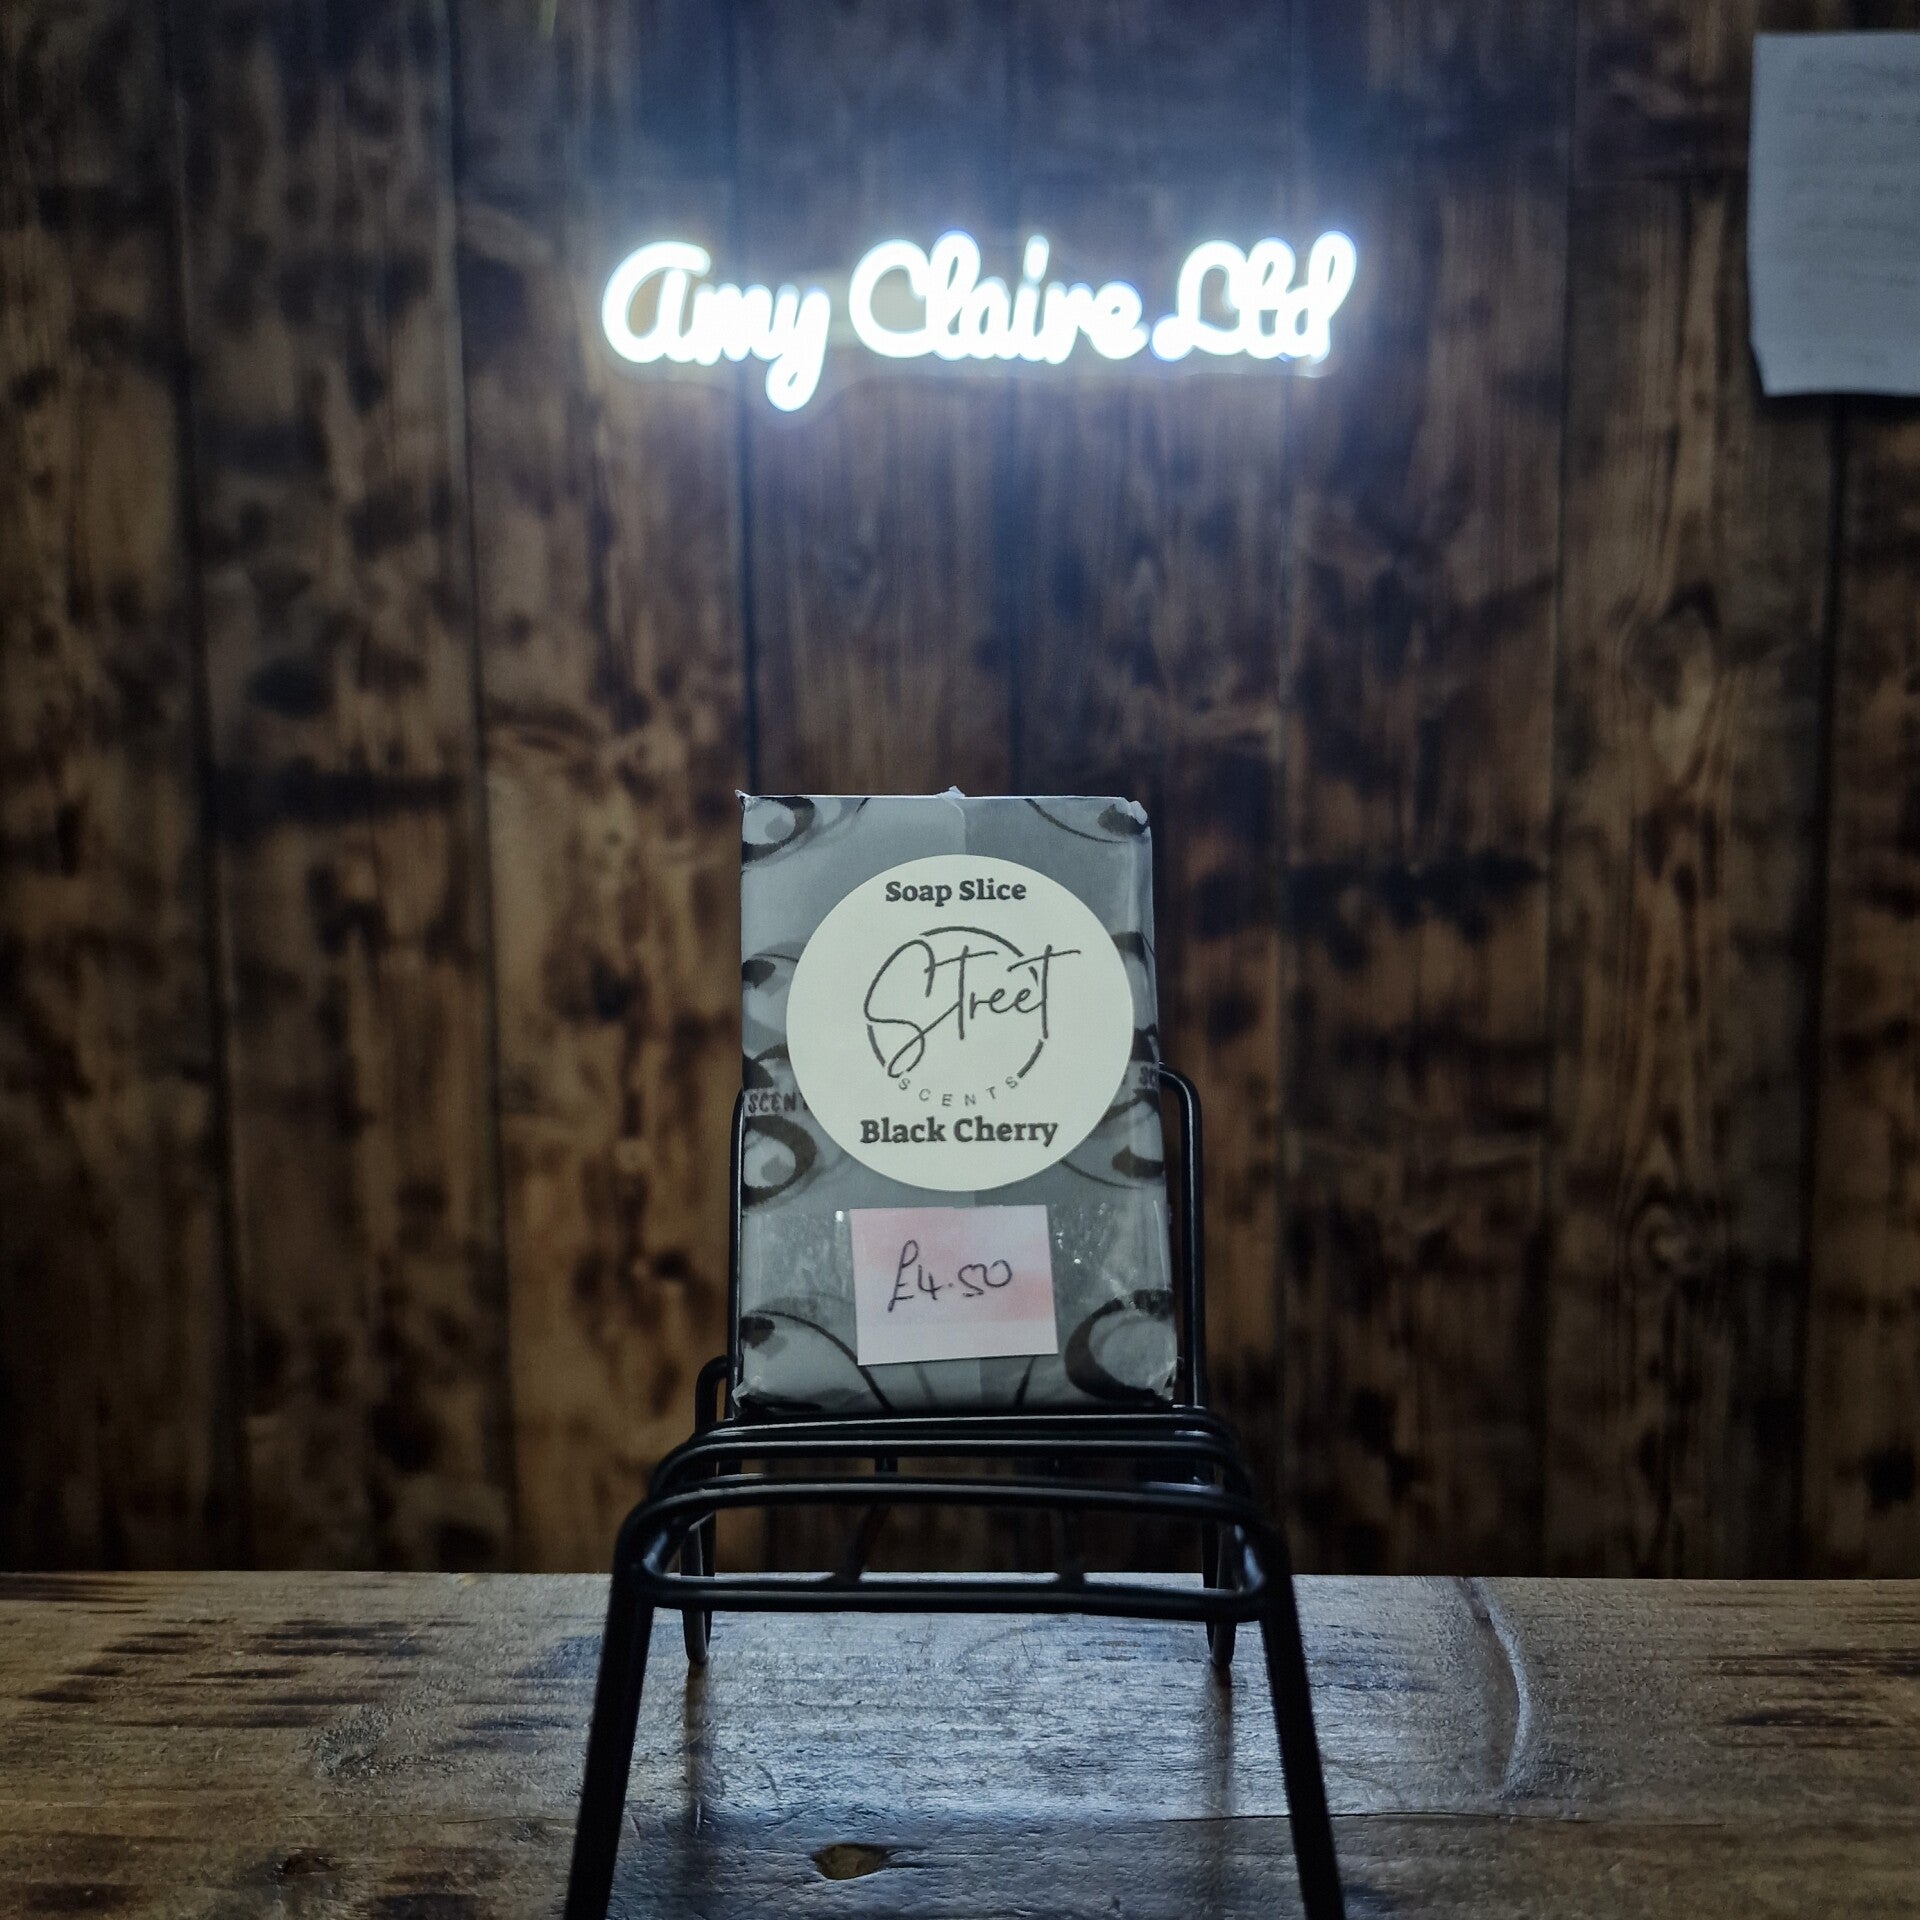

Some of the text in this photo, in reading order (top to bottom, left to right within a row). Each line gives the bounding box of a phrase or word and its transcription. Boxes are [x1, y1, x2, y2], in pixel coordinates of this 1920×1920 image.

[602, 230, 1357, 411] Amy Claire Ltd
[885, 878, 1027, 907] Soap Slice
[898, 1076, 1019, 1107] SCENTS
[860, 1116, 1058, 1147] Black Cherry
[886, 1239, 1013, 1313] £4.50
